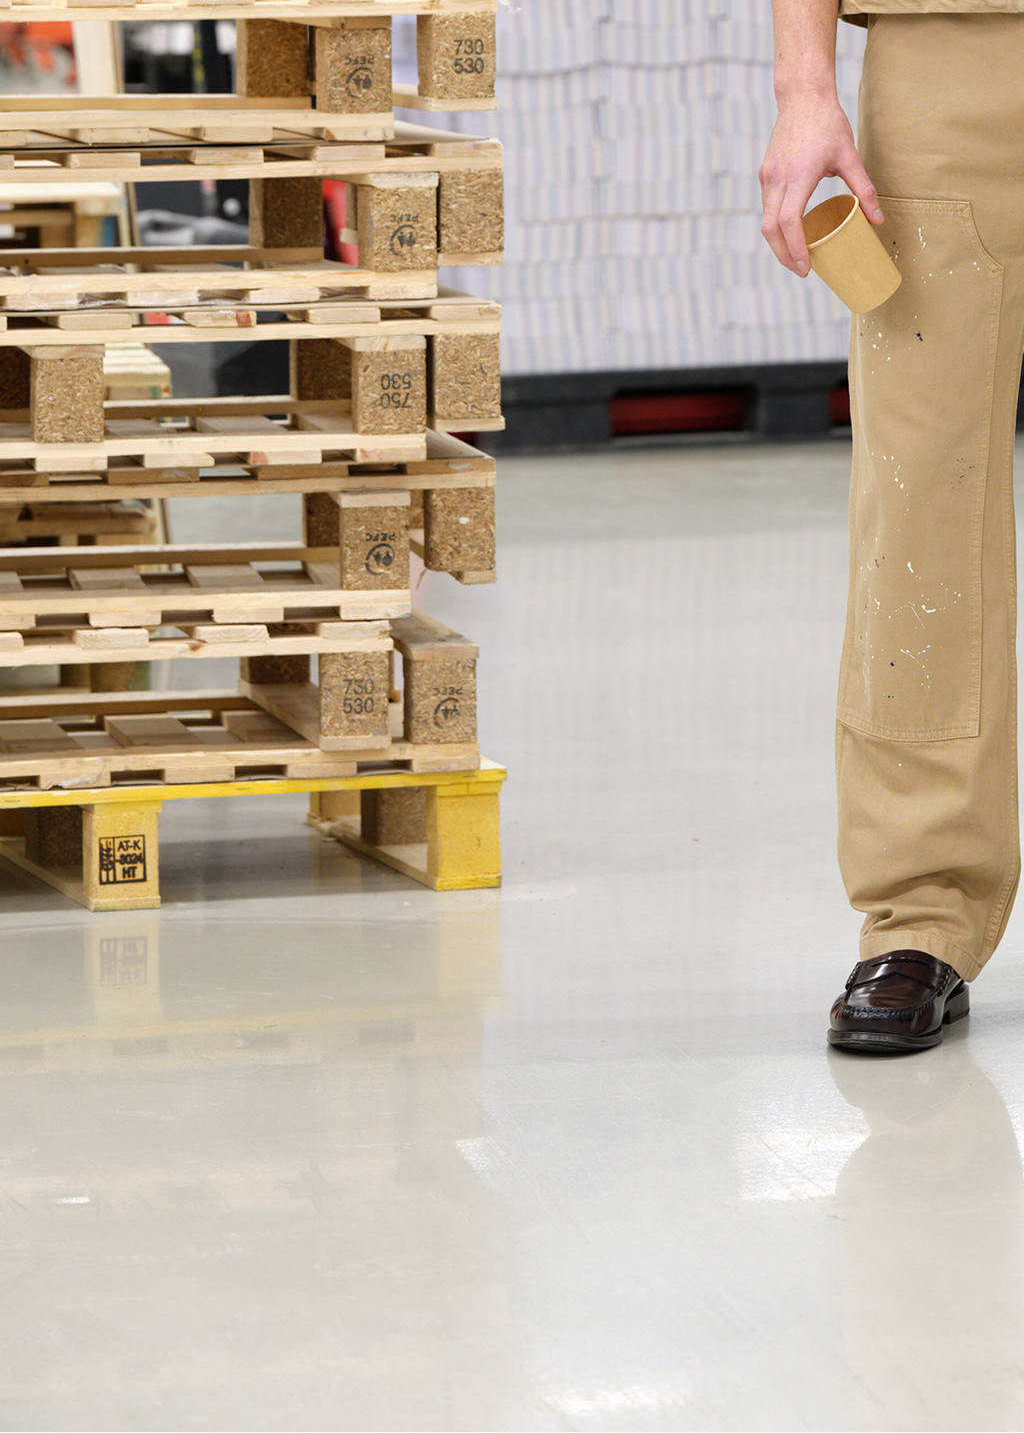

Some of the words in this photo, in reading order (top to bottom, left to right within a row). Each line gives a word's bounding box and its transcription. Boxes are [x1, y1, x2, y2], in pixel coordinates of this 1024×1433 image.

[453, 38, 484, 56] 730
[453, 57, 484, 74] 530
[380, 373, 412, 391] 530
[380, 392, 411, 409] 750
[343, 678, 374, 695] 730
[343, 697, 374, 714] 530
[122, 866, 138, 879] HT
